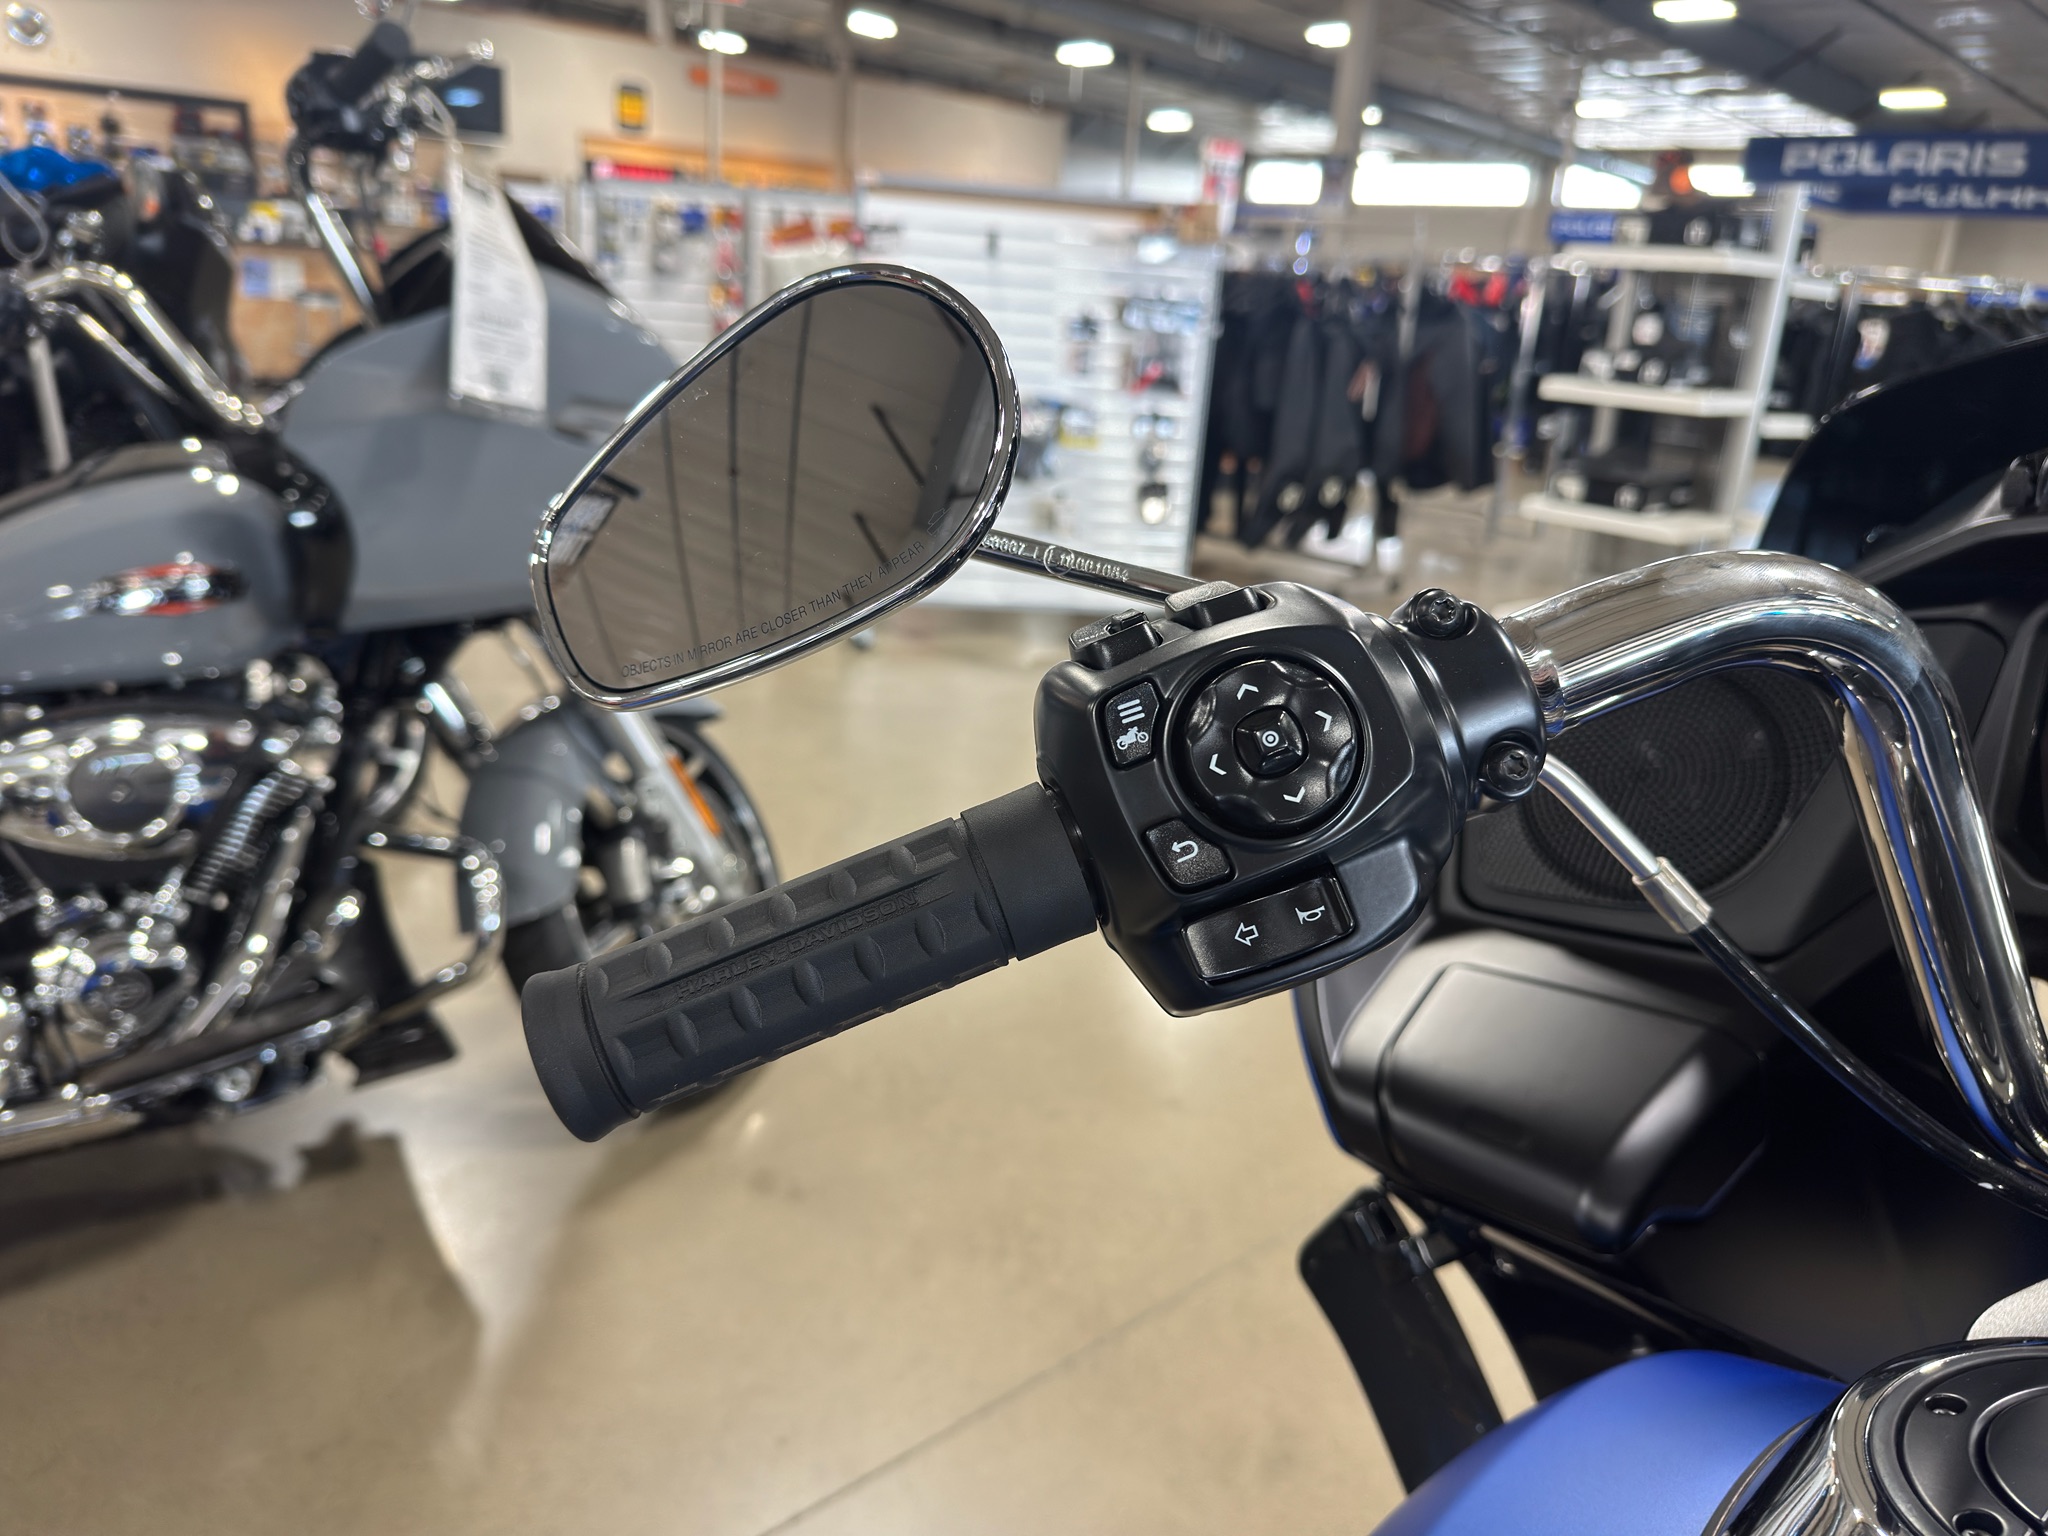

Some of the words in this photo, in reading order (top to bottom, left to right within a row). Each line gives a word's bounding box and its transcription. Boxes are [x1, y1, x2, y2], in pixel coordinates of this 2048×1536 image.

[1780, 140, 2028, 178] POLARIS
[622, 655, 671, 678] OBJECTS
[674, 651, 685, 666] IN
[687, 635, 732, 662] MIRROR
[735, 626, 759, 645] ARE
[760, 605, 808, 635] CLOSER
[808, 589, 842, 613] THAN
[842, 571, 873, 596] THEY
[877, 541, 925, 578] APPEAR
[675, 888, 919, 1000] HARLEY-DAVIDSON
